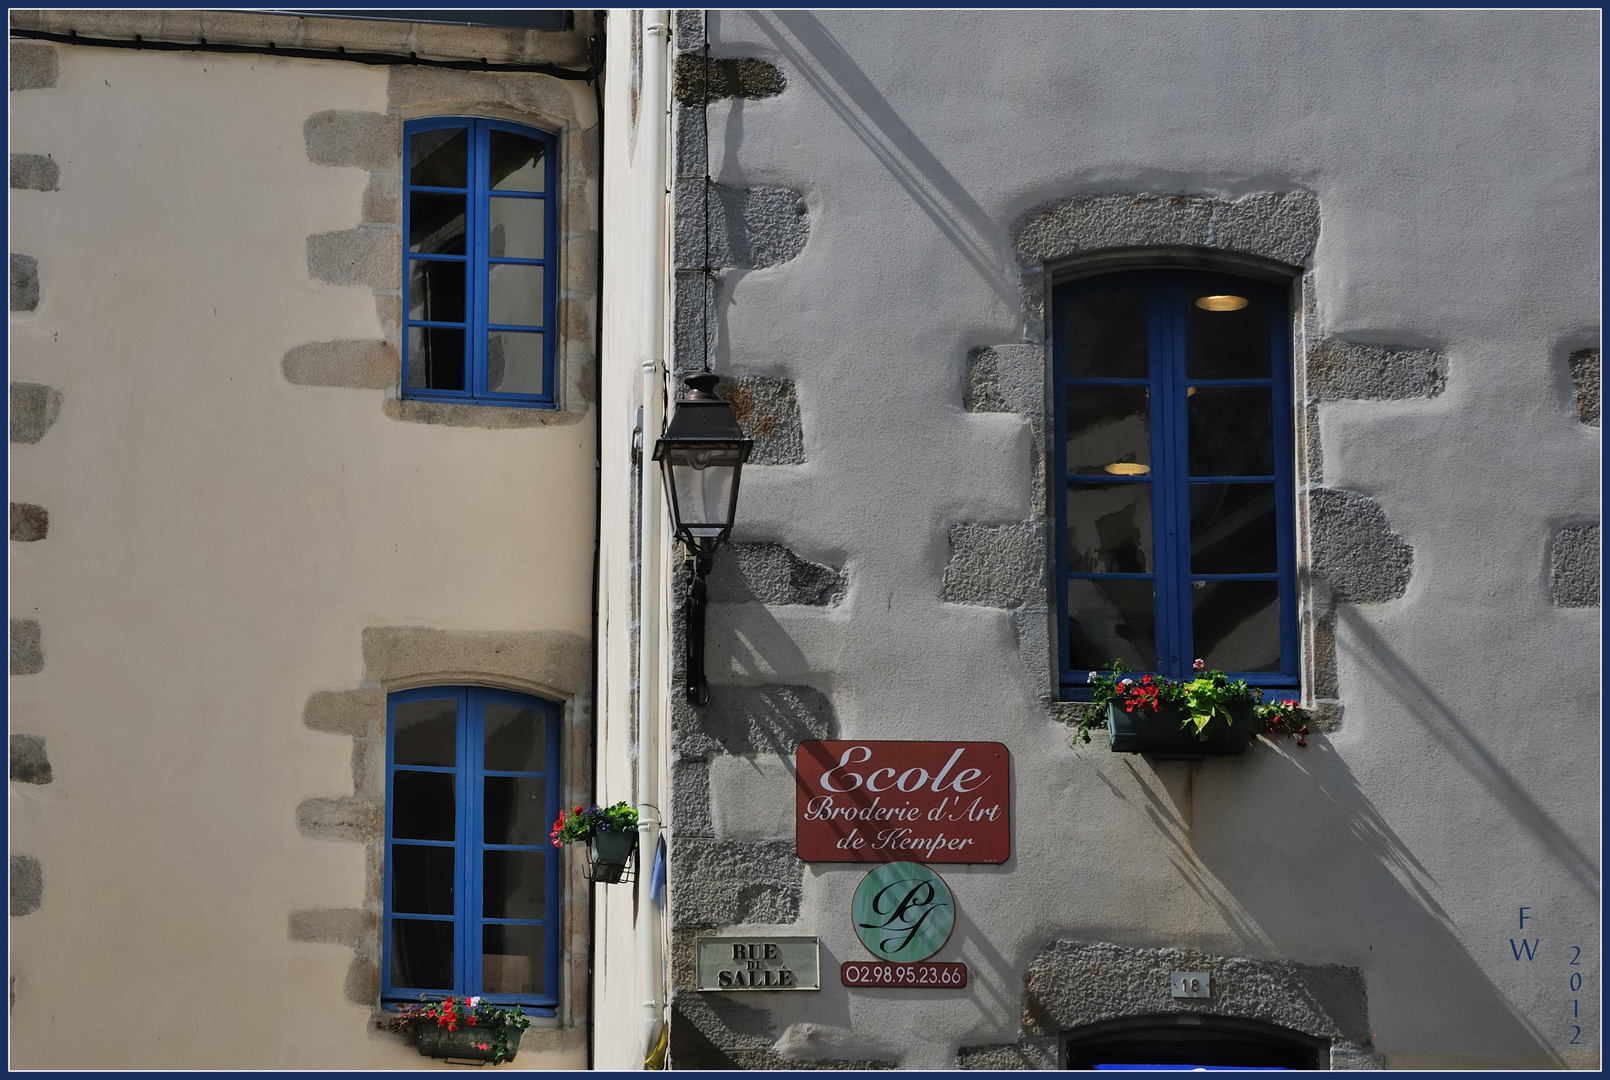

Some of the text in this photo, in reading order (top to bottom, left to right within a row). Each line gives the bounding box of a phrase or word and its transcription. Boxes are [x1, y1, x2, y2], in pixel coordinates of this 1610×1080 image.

[819, 745, 992, 794] Ecole
[803, 795, 1002, 822] Broderie d'Art
[836, 827, 974, 858] de Kemper
[730, 942, 778, 961] RUE
[845, 966, 962, 984] 02.98.95.23.66
[1180, 977, 1200, 992] 18
